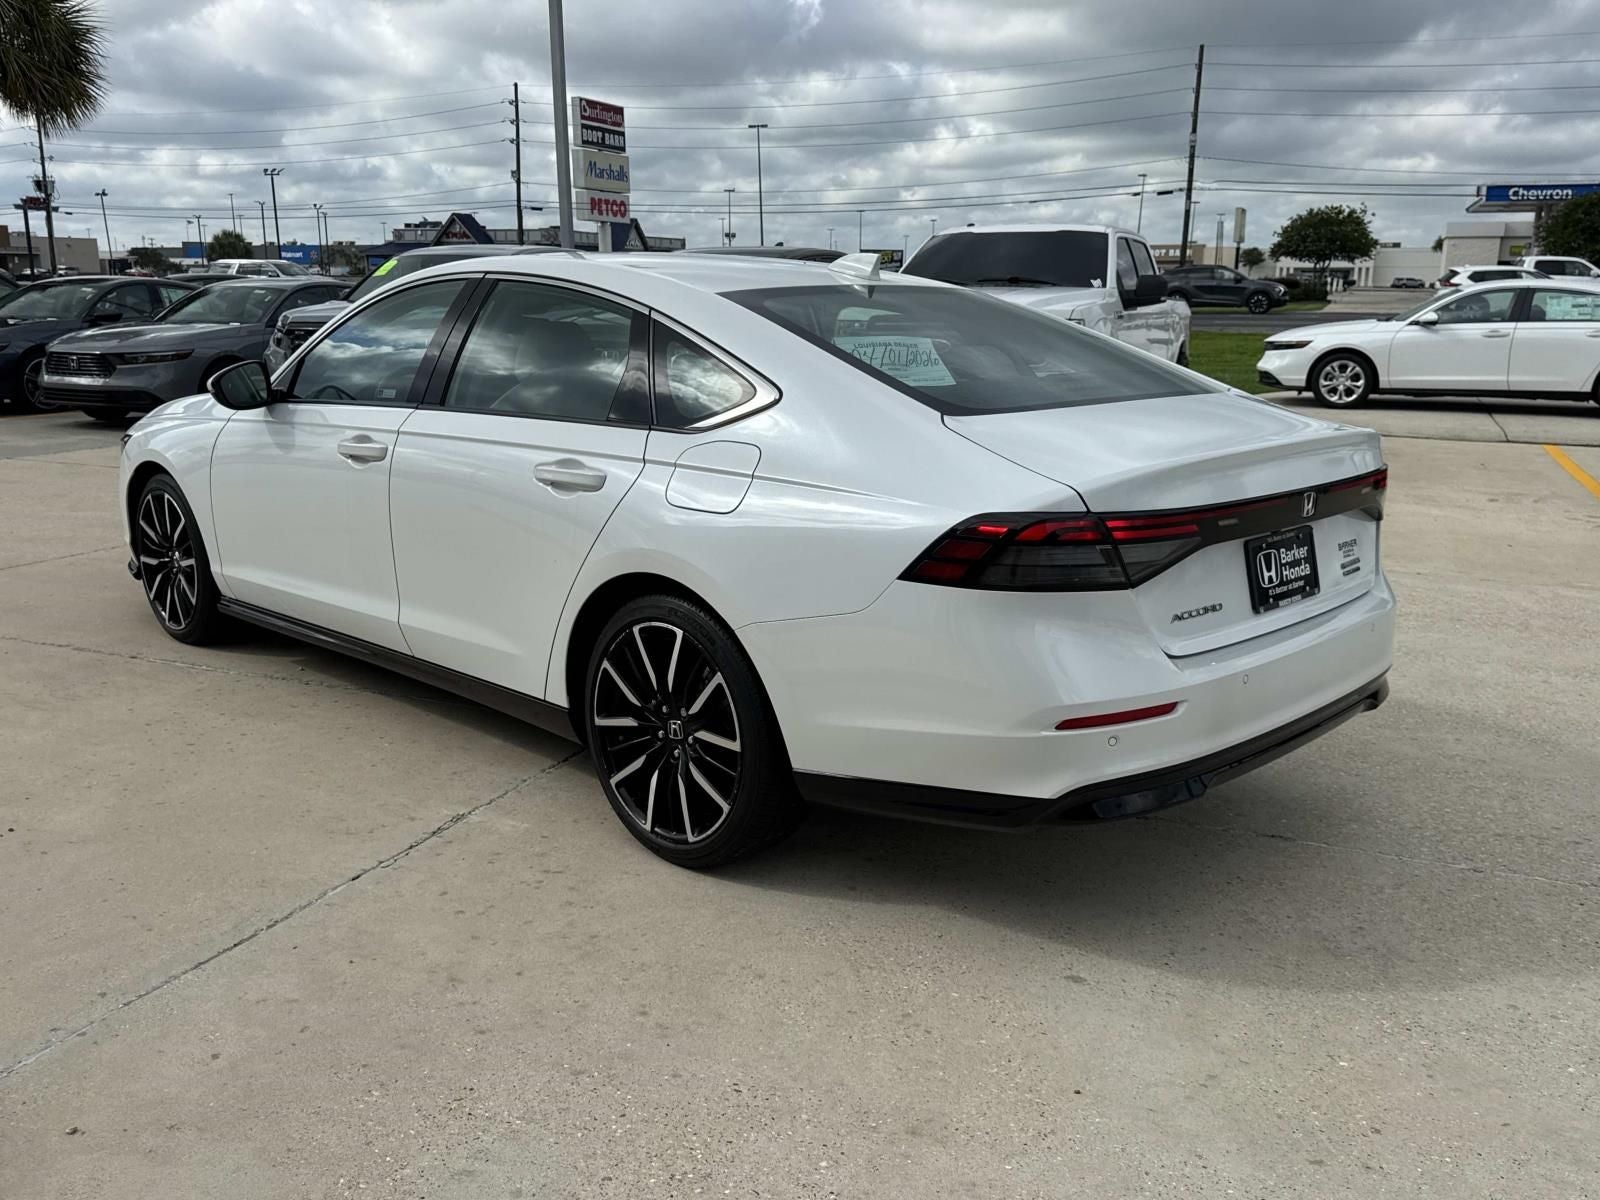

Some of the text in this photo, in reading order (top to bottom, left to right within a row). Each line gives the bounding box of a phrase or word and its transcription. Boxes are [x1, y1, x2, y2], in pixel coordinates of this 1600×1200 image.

[581, 100, 623, 127] Burlington
[582, 129, 624, 147] BOOT BARN
[586, 161, 628, 182] Marshalls
[1508, 187, 1572, 200] Chevron
[590, 197, 627, 218] PETCO
[1280, 544, 1308, 563] Barker
[1282, 560, 1310, 581] Honda
[1170, 603, 1222, 624] ACCORD
